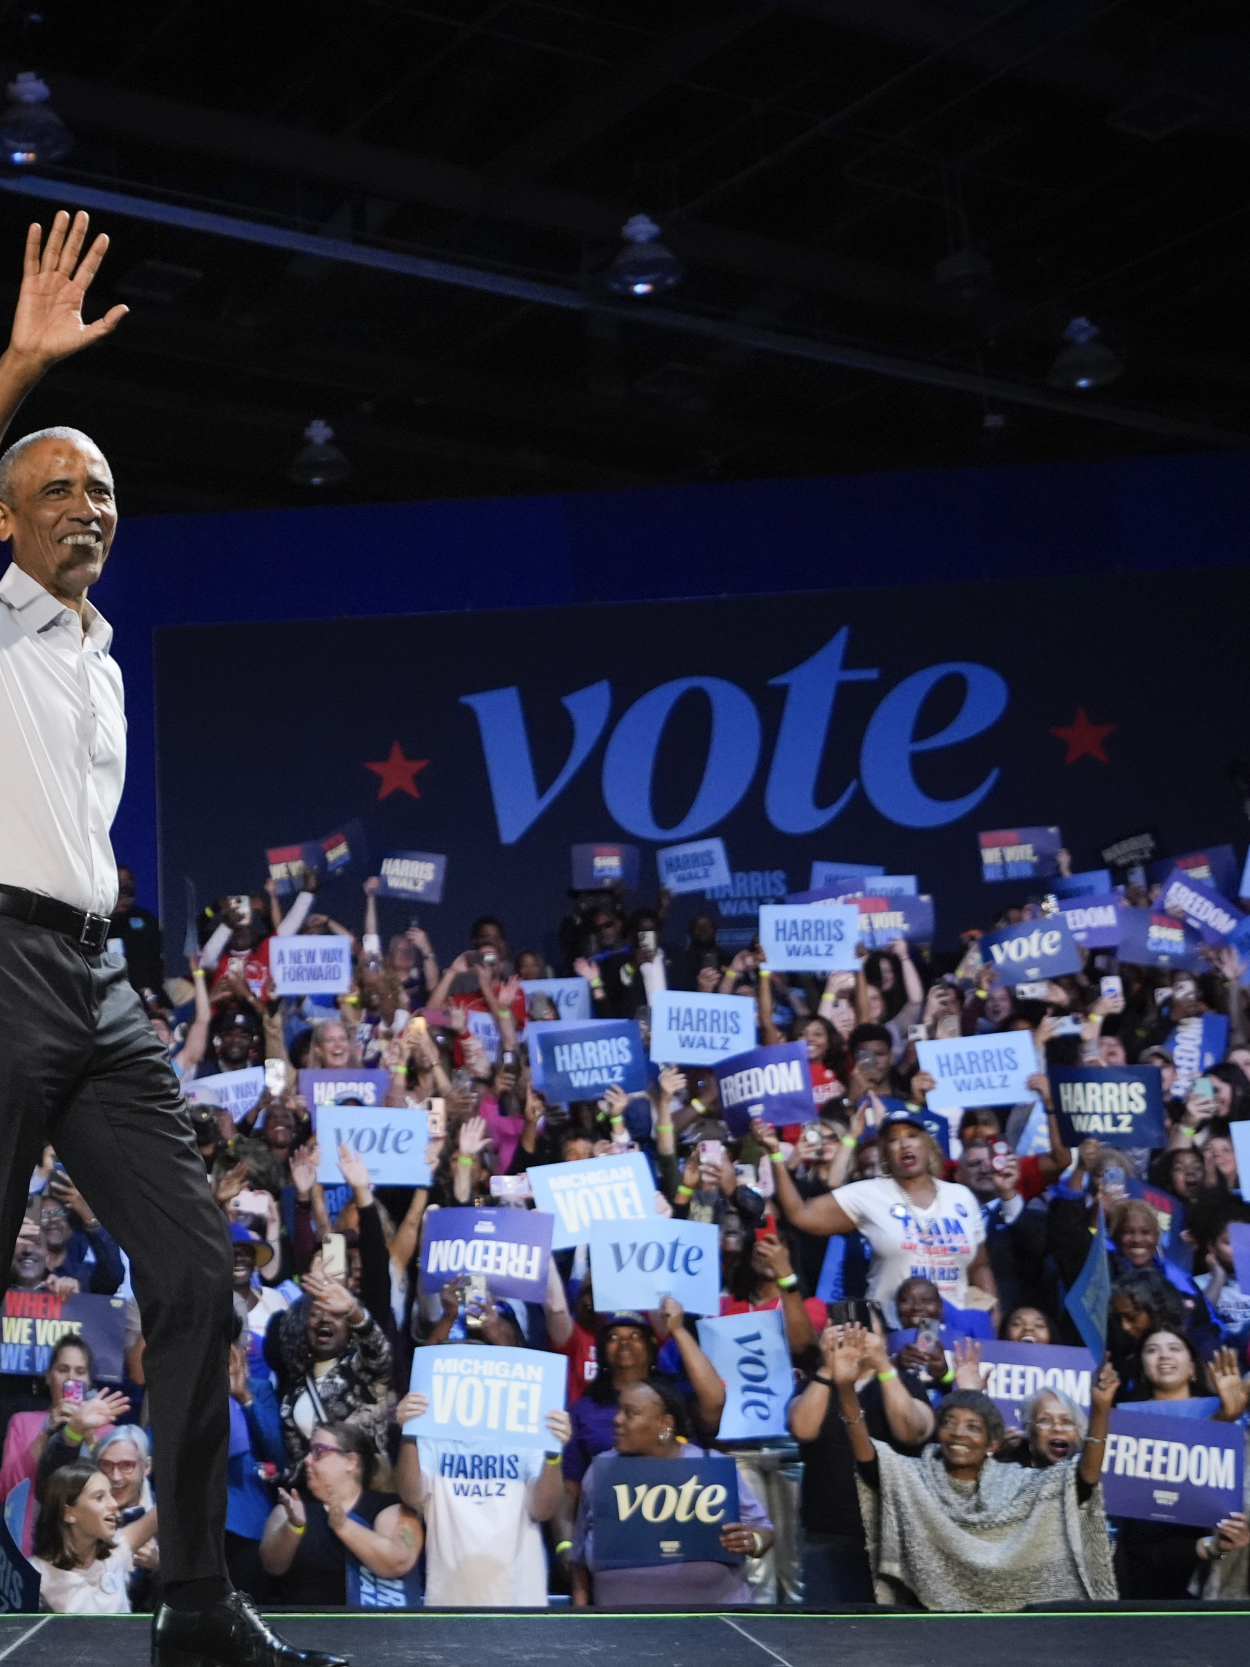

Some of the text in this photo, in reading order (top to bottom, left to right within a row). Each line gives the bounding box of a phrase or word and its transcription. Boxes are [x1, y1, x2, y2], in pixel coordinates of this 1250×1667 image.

[459, 626, 1009, 844] vote
[381, 858, 435, 881] HARRIS
[665, 850, 714, 875] HARRIS
[387, 876, 425, 892] WALZ
[718, 898, 776, 916] WAL
[1066, 904, 1118, 930] EDOM
[1163, 880, 1238, 935] FREEDOM
[775, 918, 844, 941] HARRIS
[277, 947, 344, 965] A NEW WAY
[785, 943, 834, 957] WALZ
[989, 928, 1062, 965] vote
[282, 963, 342, 982] FORWARD
[668, 1006, 740, 1034] HARRIS
[554, 1036, 632, 1072] HARRIS
[678, 1034, 730, 1050] WALZ
[568, 1064, 625, 1088] WALZ
[935, 1047, 1018, 1079] HARRIS
[719, 1060, 804, 1107] FREEDOM
[952, 1074, 1010, 1092] WALZ
[1059, 1081, 1147, 1114] HARRIS
[1070, 1113, 1133, 1133] WALZ
[334, 1122, 414, 1154] vote
[548, 1165, 635, 1192] MICHIGAN
[553, 1178, 647, 1235] VOTE!
[427, 1239, 542, 1282] FREEDOM
[609, 1236, 704, 1277] vote
[5, 1290, 62, 1319] WHEN
[2, 1317, 33, 1345] WE
[0, 1343, 31, 1371] WE
[433, 1357, 543, 1381] MICHIGAN
[733, 1330, 780, 1422] vote
[978, 1361, 1092, 1407] REEDOM
[432, 1374, 543, 1434] VOTE!
[439, 1453, 519, 1480] HARRIS
[1103, 1434, 1236, 1490] FREEDOM
[453, 1481, 507, 1498] WALZ
[612, 1474, 727, 1524] vote
